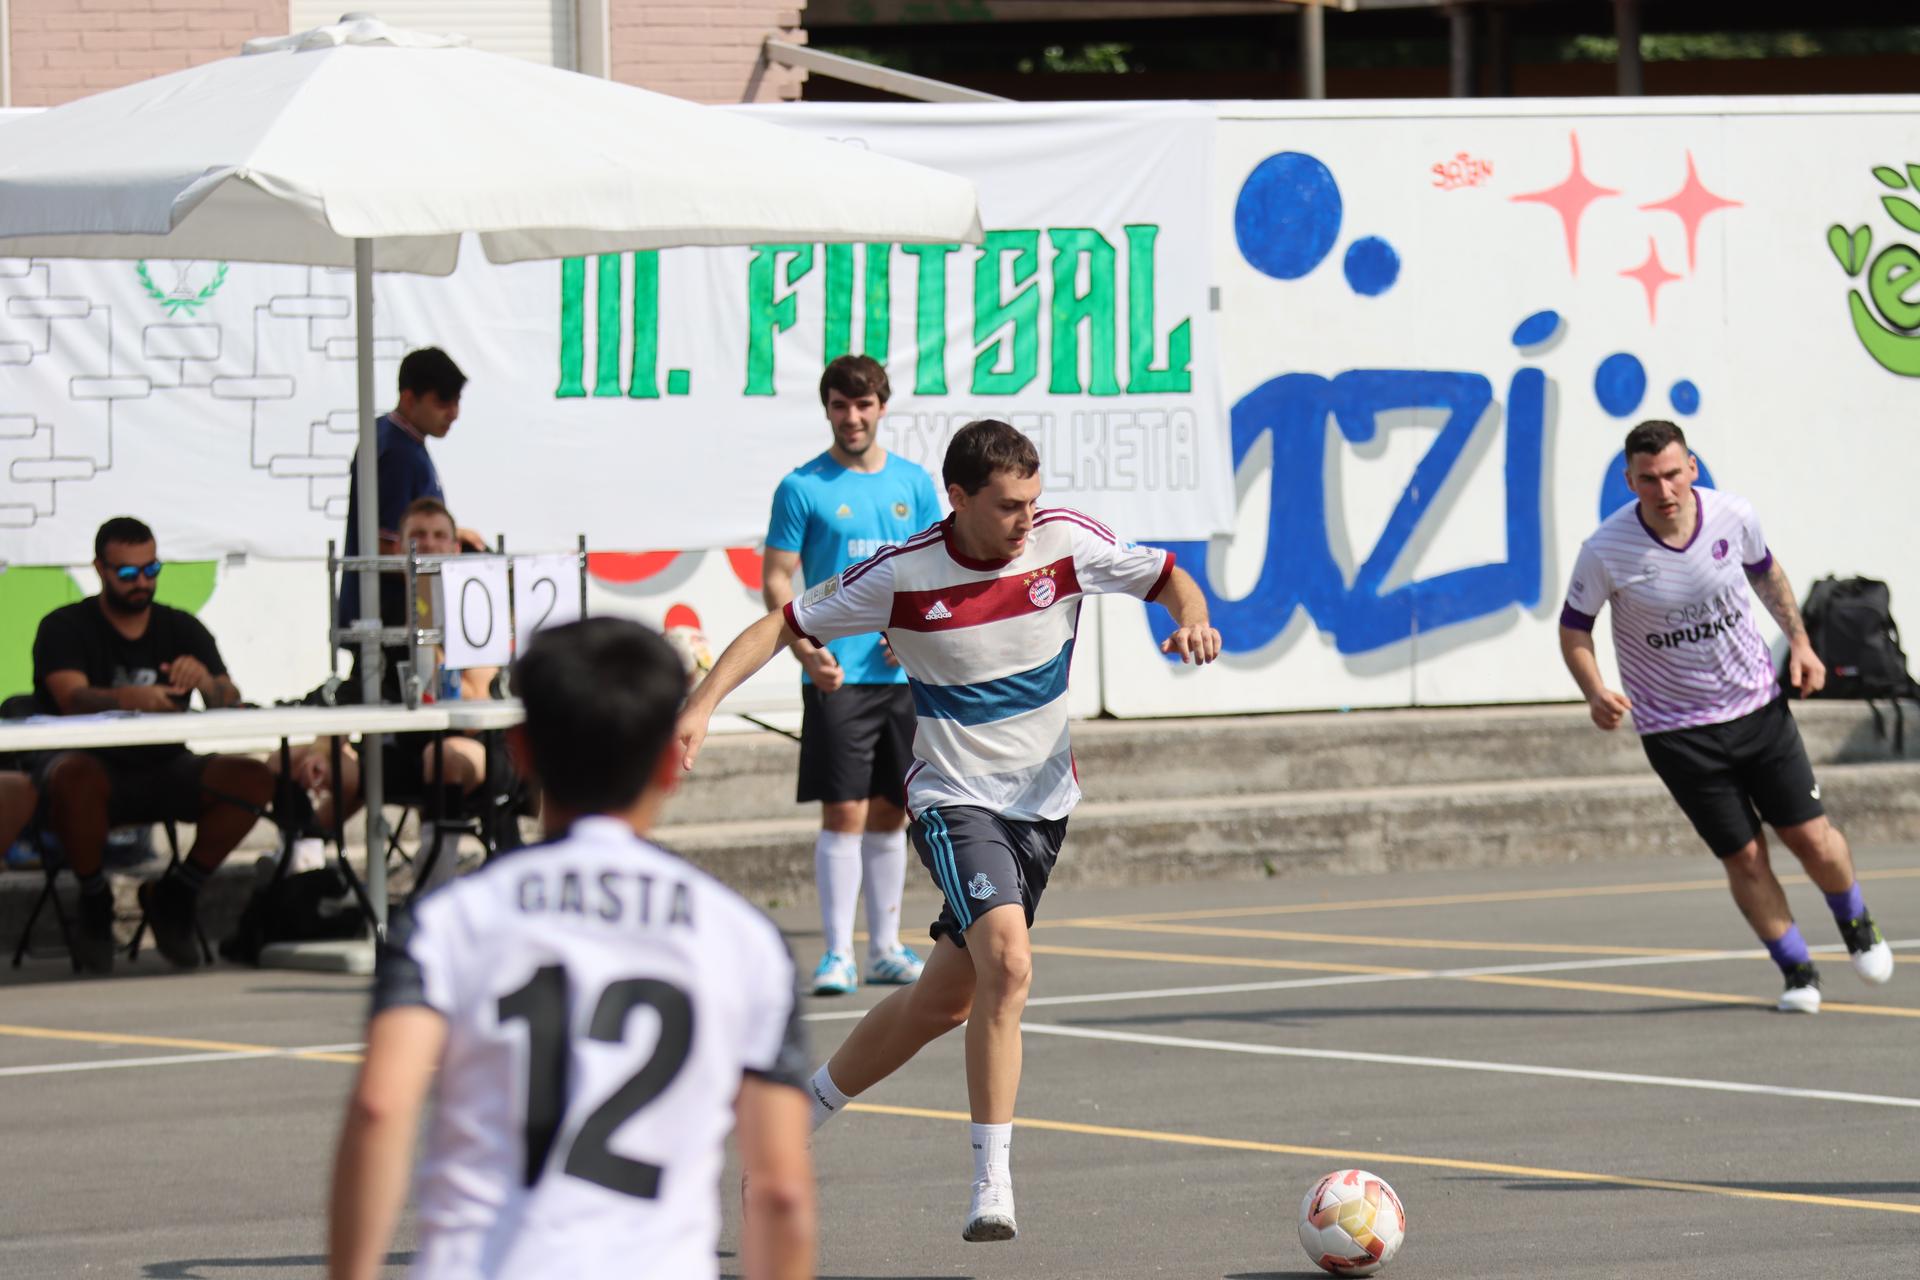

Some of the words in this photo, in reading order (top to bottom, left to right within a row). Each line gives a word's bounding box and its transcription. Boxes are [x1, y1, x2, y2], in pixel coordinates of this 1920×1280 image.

[744, 225, 1192, 396] FUTSAL
[883, 407, 1199, 492] TXLKETA
[461, 577, 493, 648] 0
[532, 577, 557, 634] 2
[925, 612, 952, 620] adidas
[517, 872, 694, 927] GASTA
[496, 963, 694, 1201] 12
